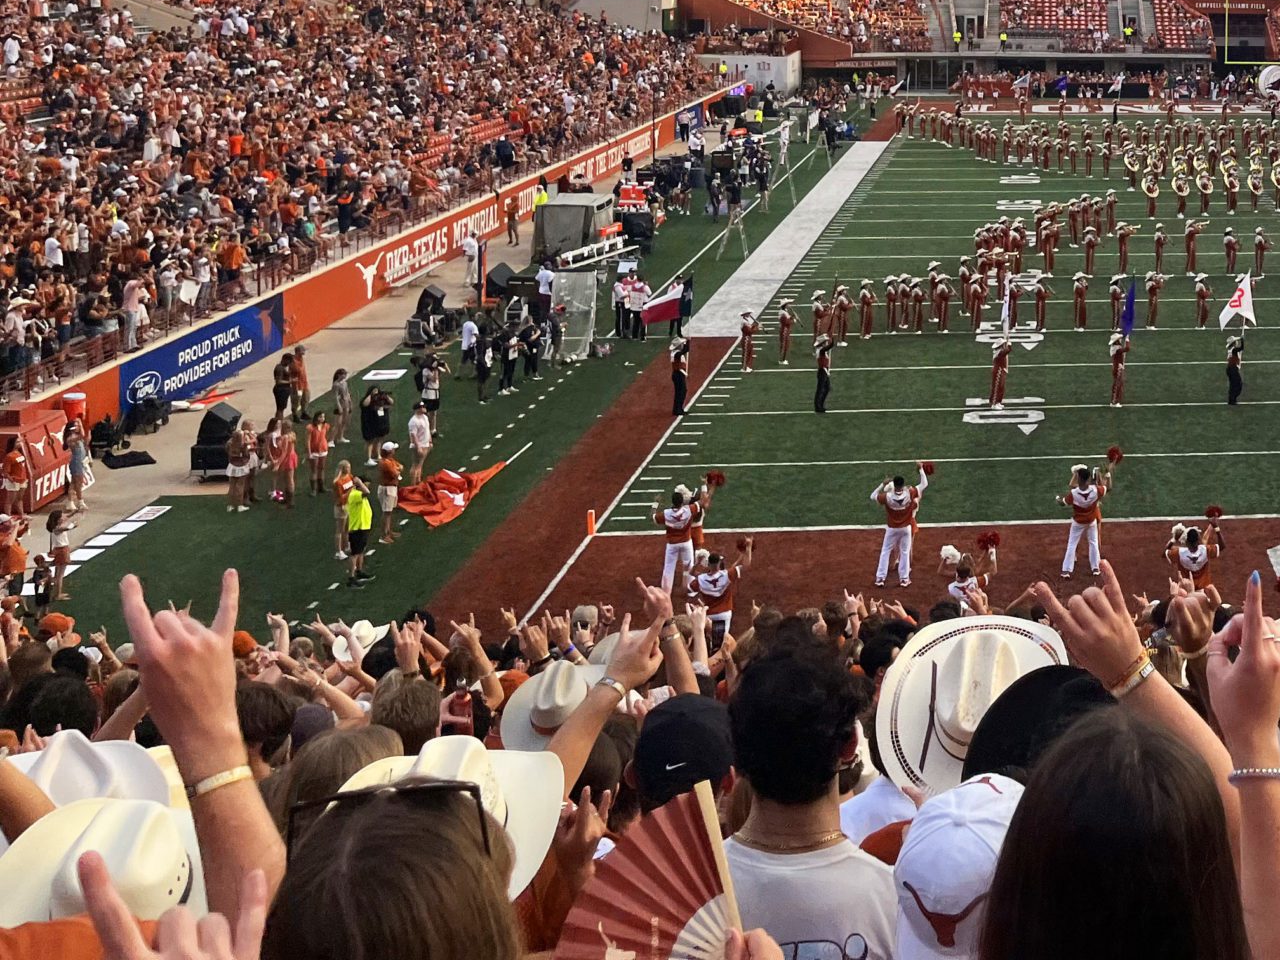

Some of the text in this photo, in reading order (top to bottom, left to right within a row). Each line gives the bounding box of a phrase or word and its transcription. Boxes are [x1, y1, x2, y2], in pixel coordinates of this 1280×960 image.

[385, 226, 448, 282] DKR-TEXAS
[163, 339, 253, 395] PROVIDER FOR BEVO
[178, 324, 241, 367] PROUD TRUCK
[134, 375, 156, 399] Ford
